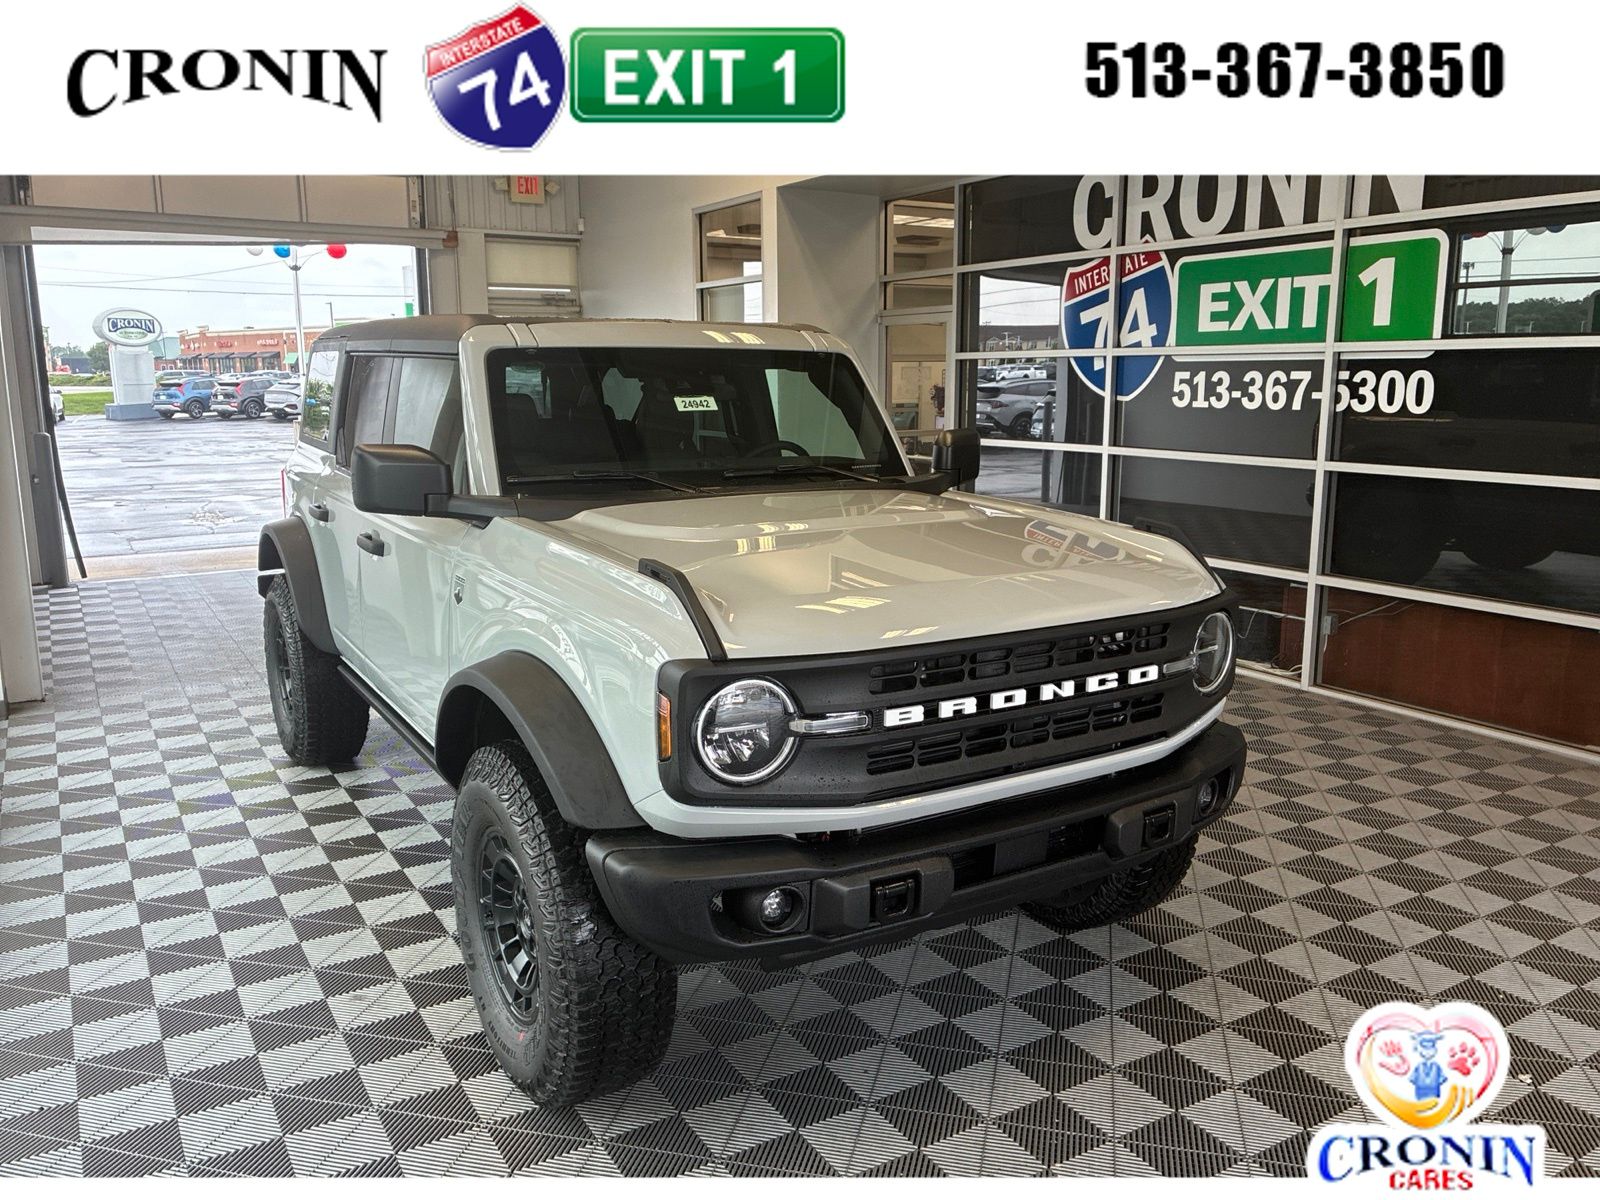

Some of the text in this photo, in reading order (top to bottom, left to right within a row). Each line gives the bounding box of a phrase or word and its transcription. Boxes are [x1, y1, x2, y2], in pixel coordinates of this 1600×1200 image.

[517, 175, 538, 194] EXIT
[1074, 253, 1148, 295] INTERATE
[1198, 257, 1396, 332] EXIT 1
[109, 319, 154, 332] CRONIN
[1080, 287, 1157, 371] 74
[682, 400, 710, 408] 24942
[1171, 369, 1435, 414] 513-367-5300
[884, 664, 1159, 727] BRONCO
